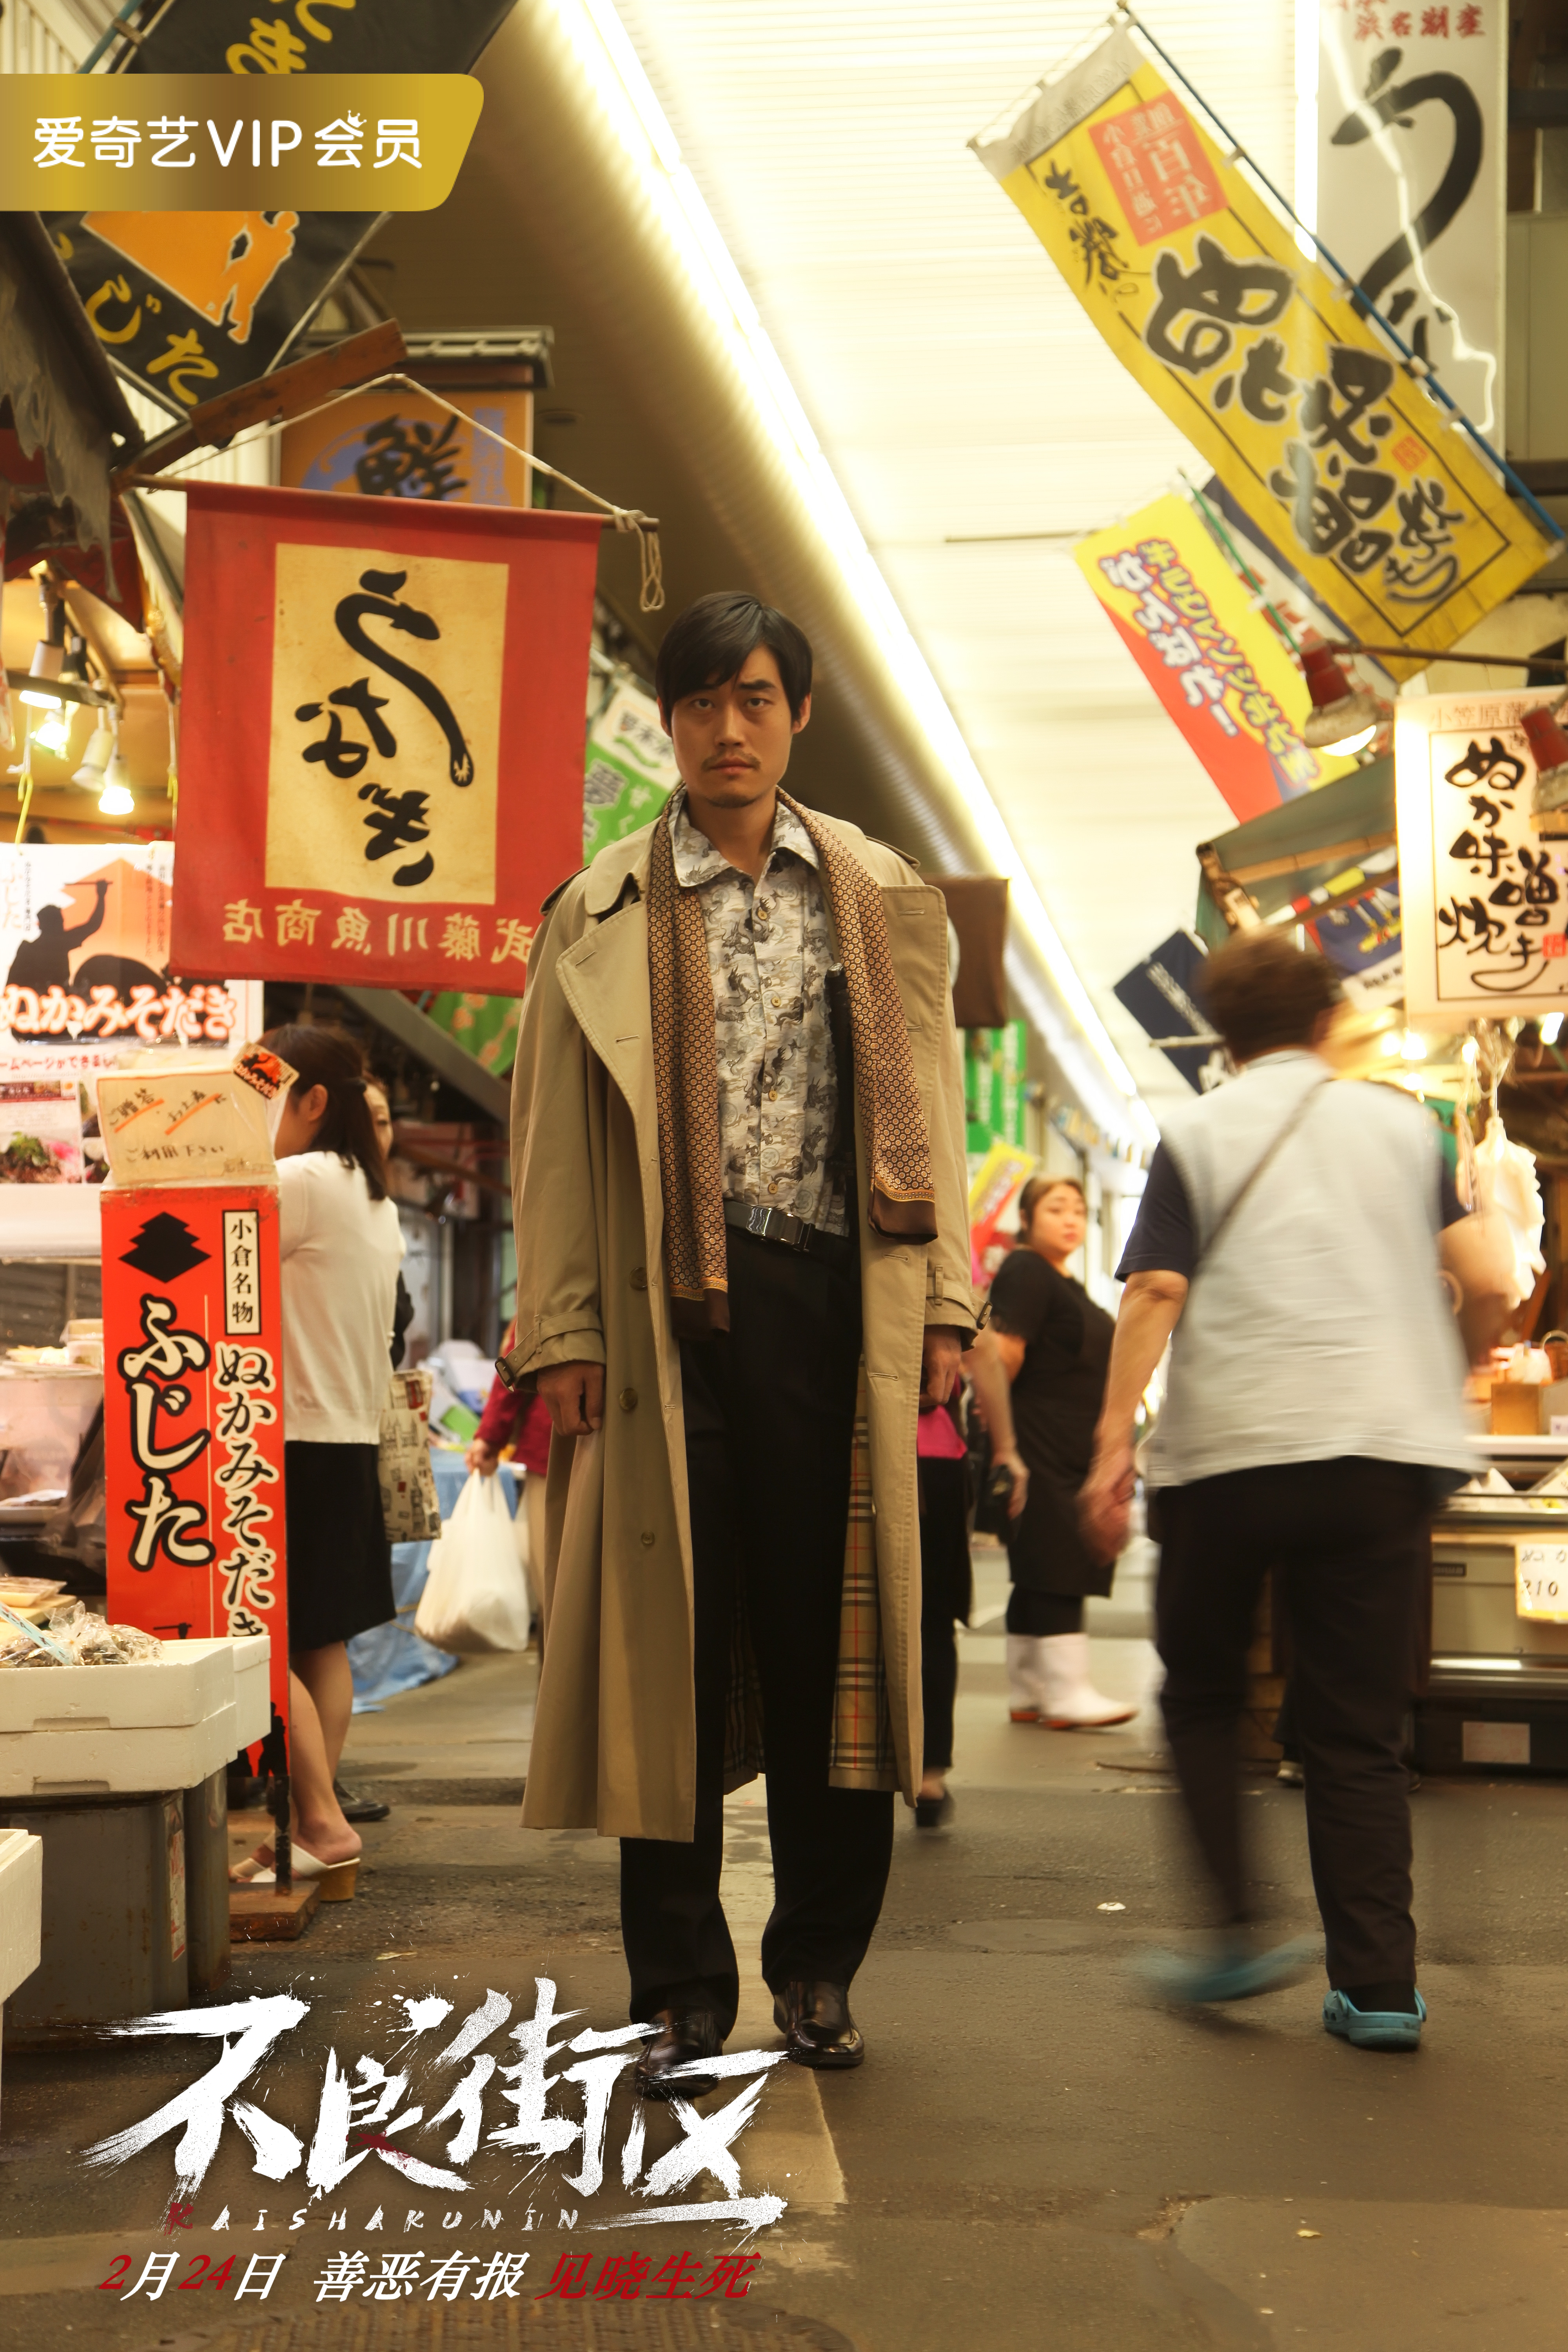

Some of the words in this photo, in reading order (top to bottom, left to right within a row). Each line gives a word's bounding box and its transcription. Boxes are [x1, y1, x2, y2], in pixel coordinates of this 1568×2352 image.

[229, 1217, 255, 1325] 小倉名物
[117, 1293, 216, 1572] ふじた
